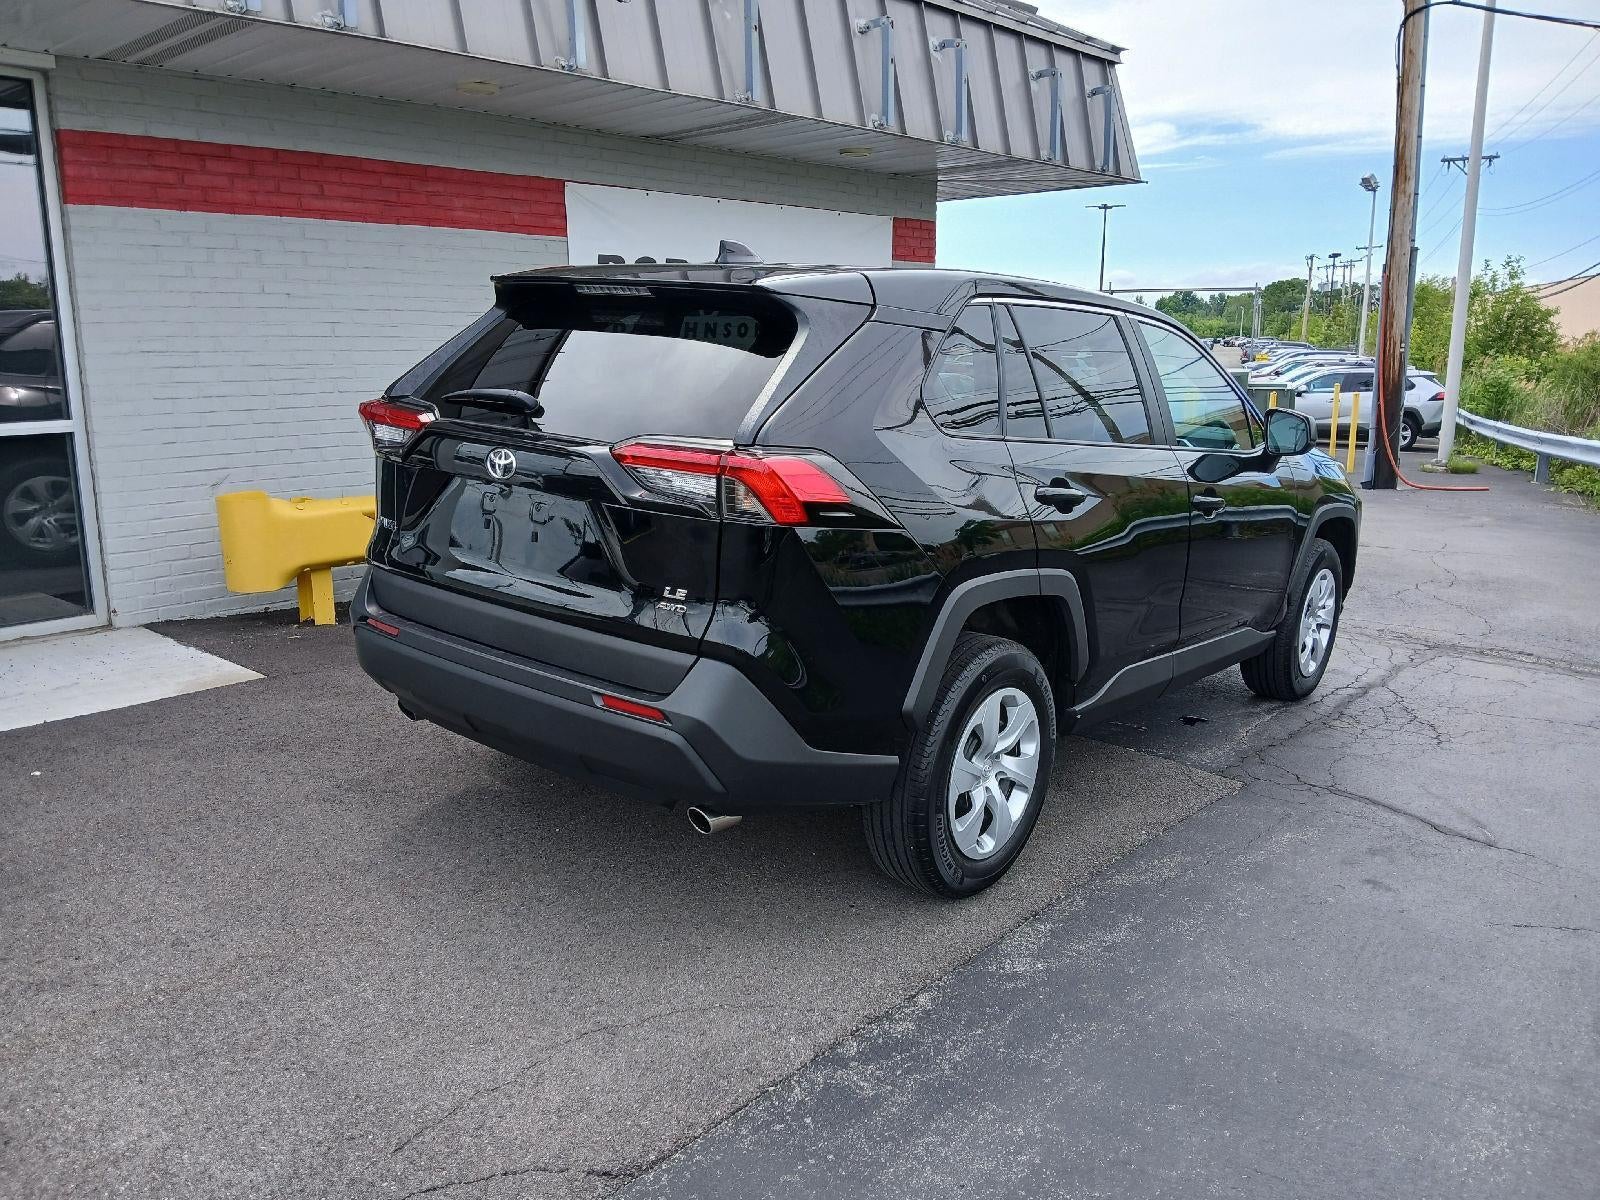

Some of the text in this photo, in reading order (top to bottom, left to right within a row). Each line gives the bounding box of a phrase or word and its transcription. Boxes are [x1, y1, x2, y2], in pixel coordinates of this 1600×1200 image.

[662, 586, 688, 600] LE
[655, 601, 687, 613] AWD
[936, 814, 956, 870] MICHELIN
